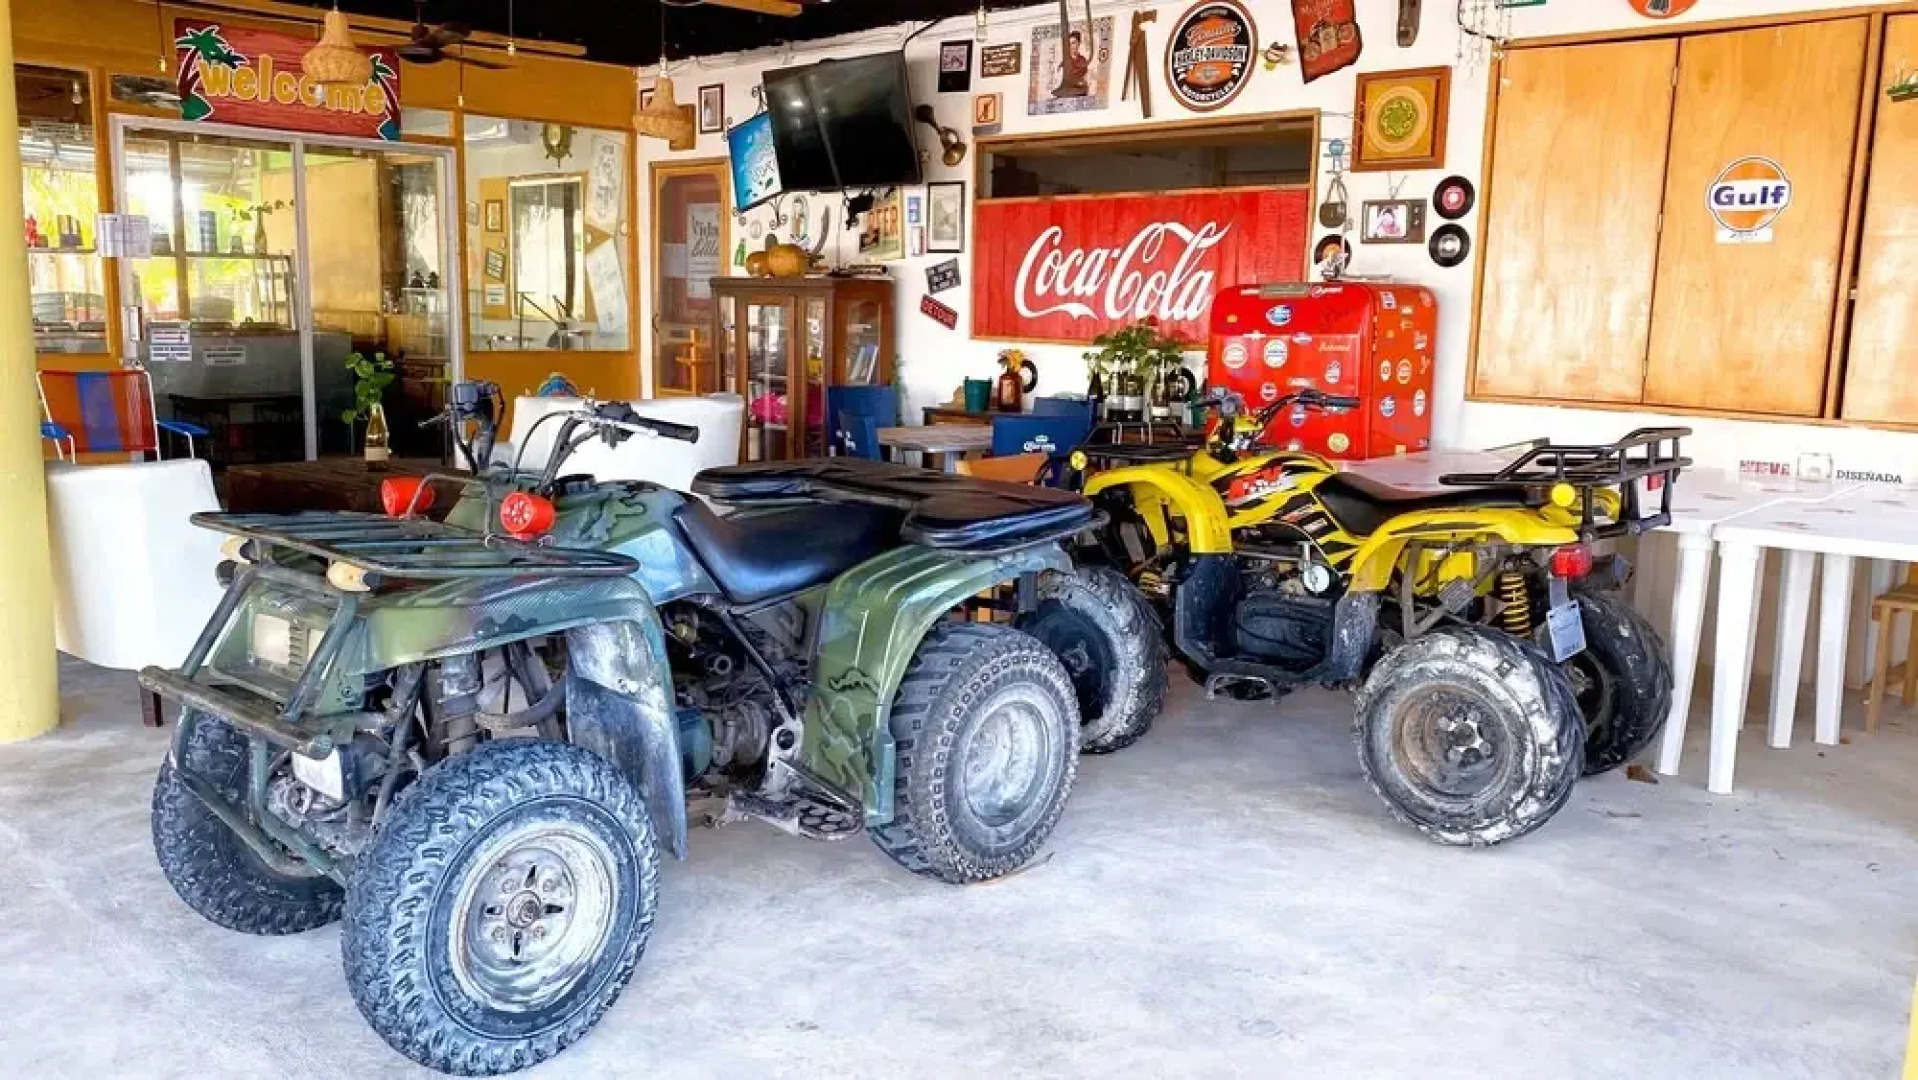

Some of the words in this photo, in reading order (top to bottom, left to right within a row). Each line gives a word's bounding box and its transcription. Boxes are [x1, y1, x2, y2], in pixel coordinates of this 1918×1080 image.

[1174, 45, 1247, 69] HARLEY-DAVIDSON
[199, 54, 386, 115] welcome
[1714, 185, 1786, 206] Gulf
[1014, 222, 1232, 321] Coca-Cola
